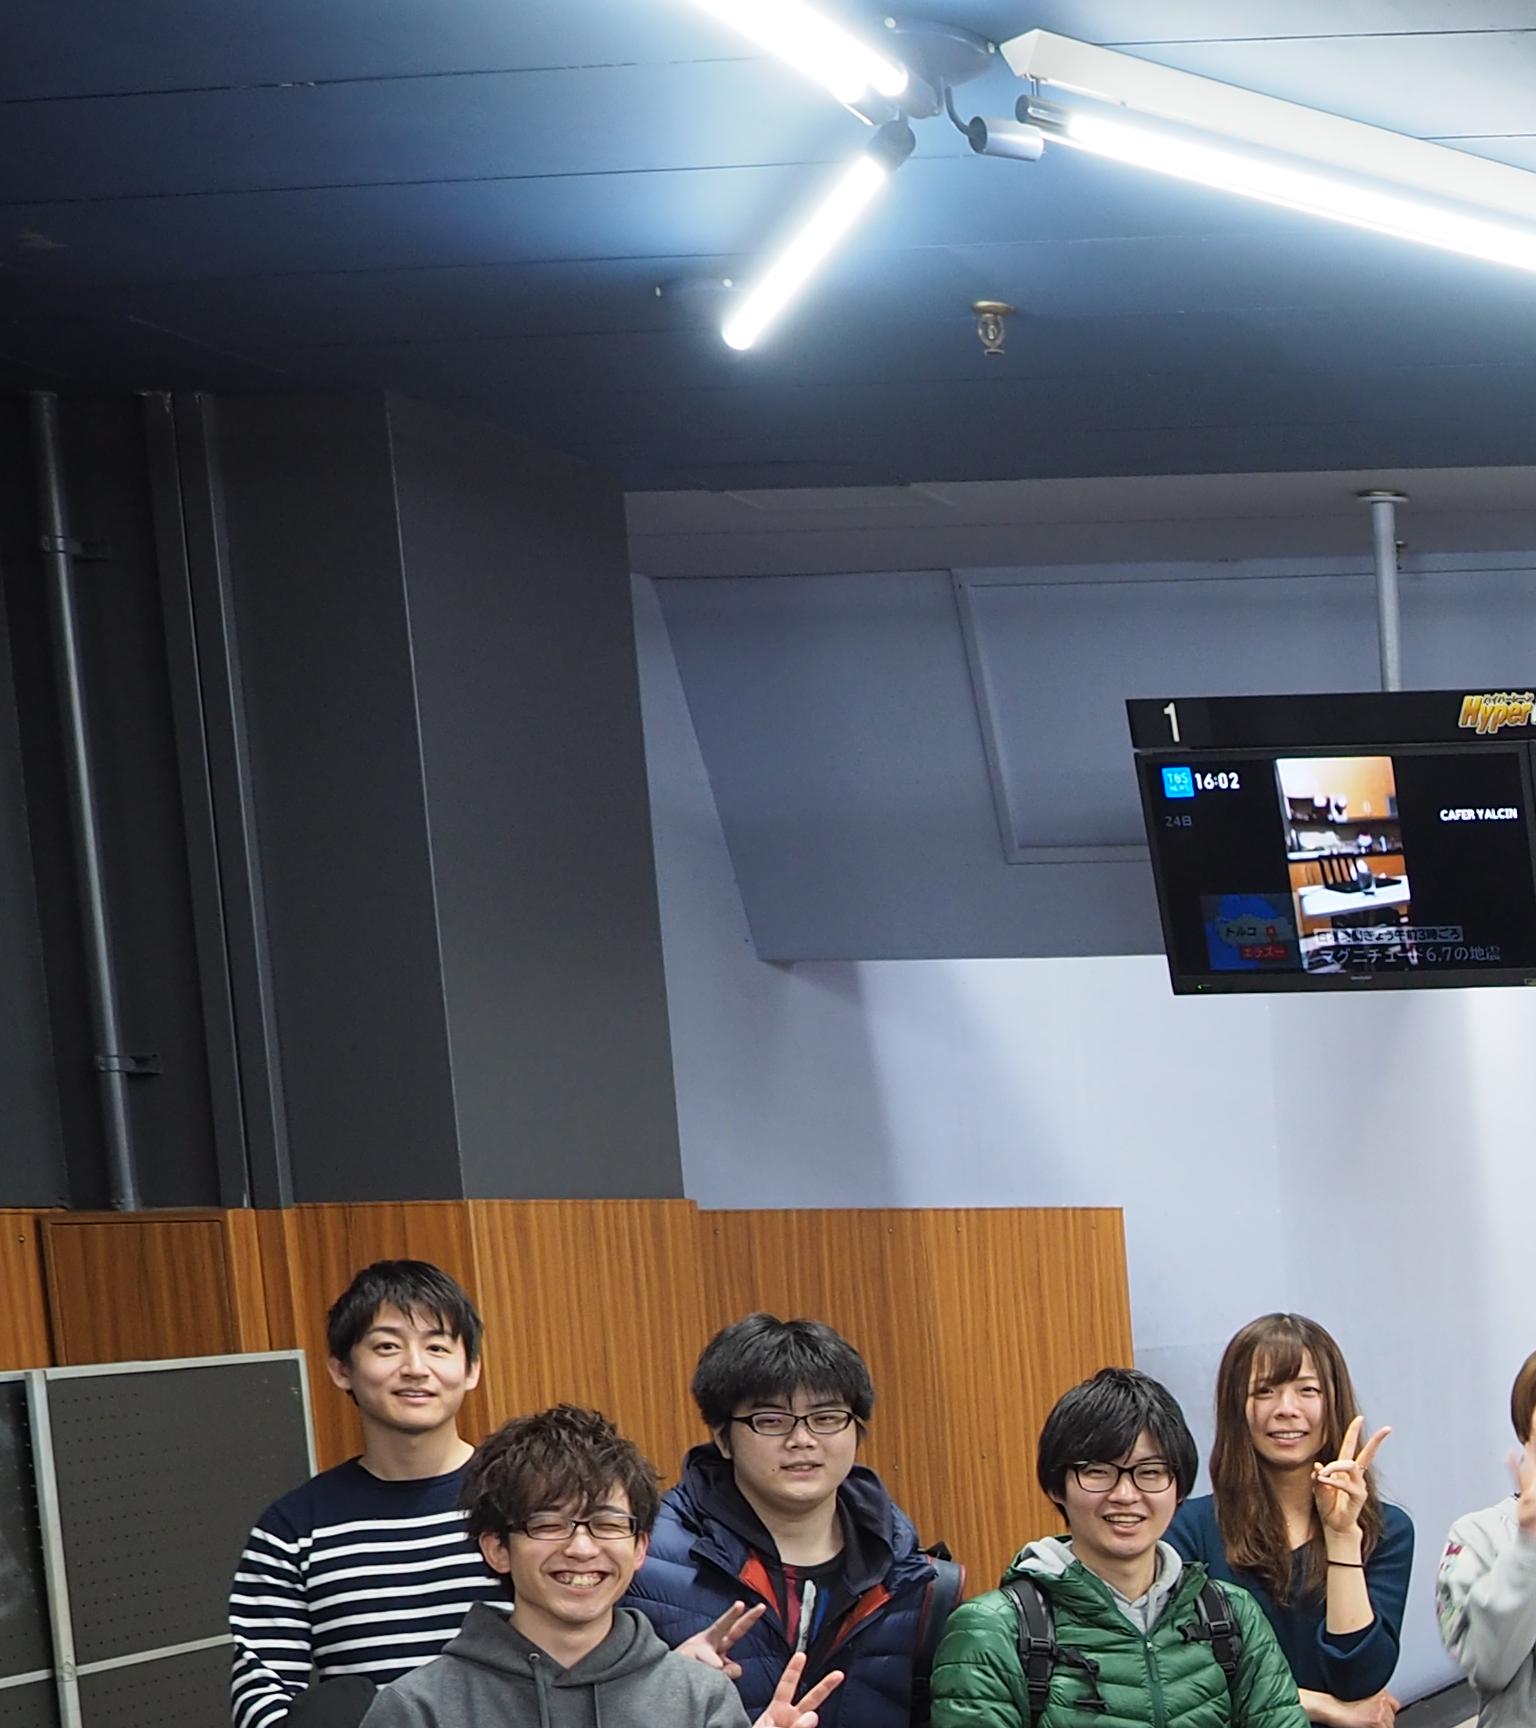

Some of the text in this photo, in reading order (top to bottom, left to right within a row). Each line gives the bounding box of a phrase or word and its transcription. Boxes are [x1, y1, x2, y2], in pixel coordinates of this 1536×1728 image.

[1163, 701, 1181, 743] 1
[1458, 694, 1533, 735] Hyper
[1194, 771, 1240, 790] 16:02
[1165, 814, 1193, 827] 24日
[1440, 809, 1475, 821] CAFER
[1225, 926, 1258, 938] トルコ
